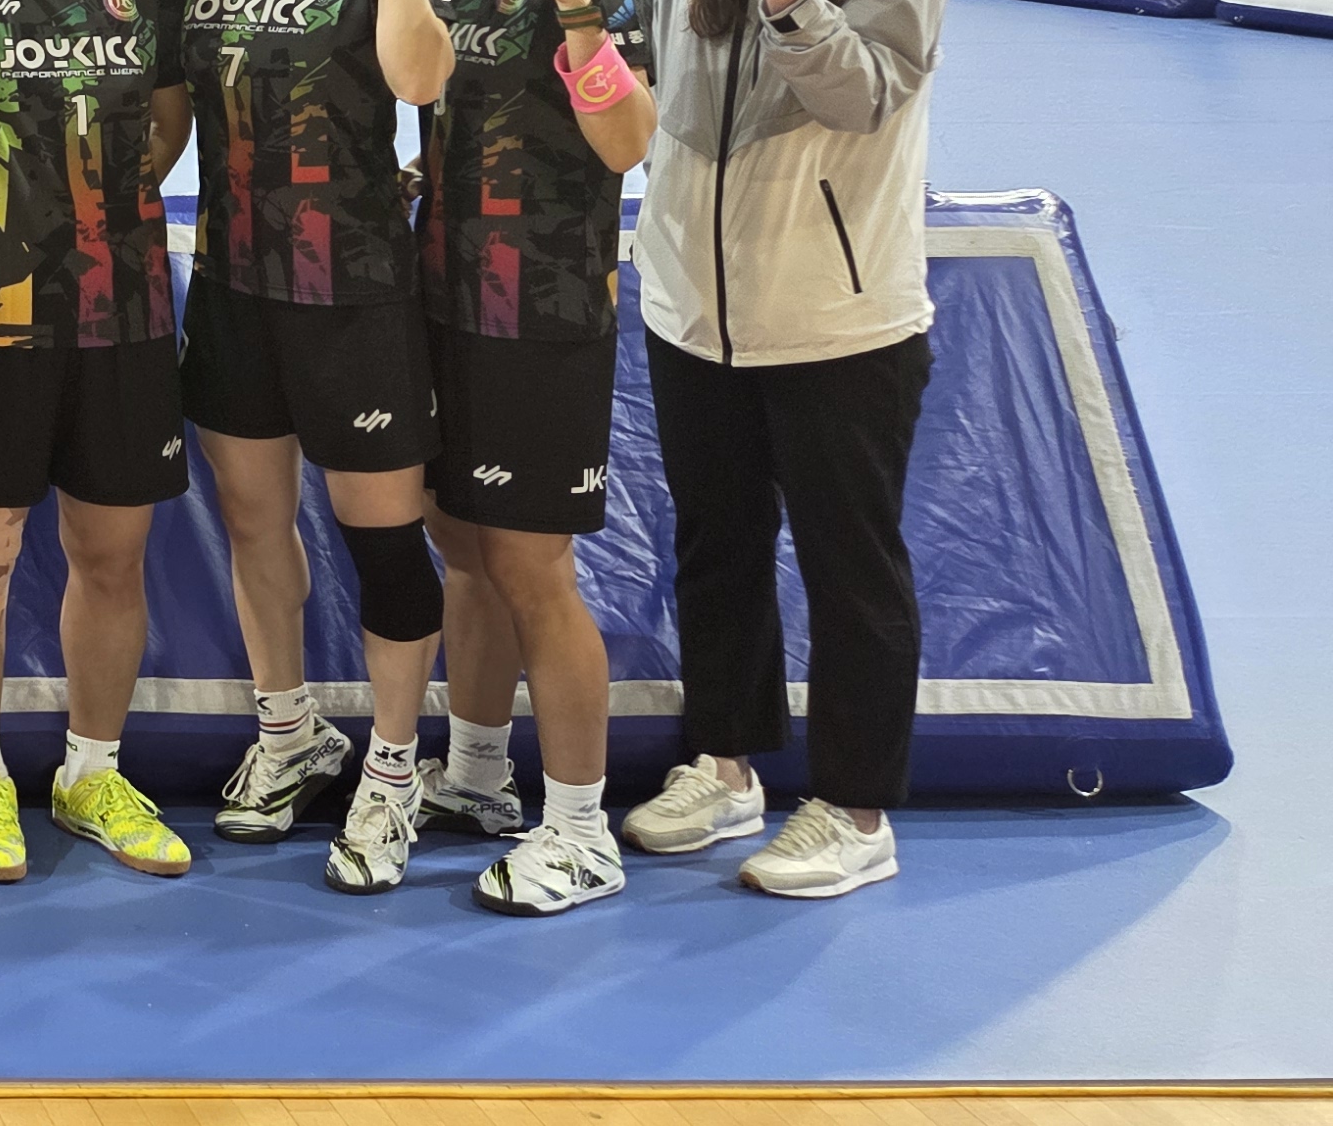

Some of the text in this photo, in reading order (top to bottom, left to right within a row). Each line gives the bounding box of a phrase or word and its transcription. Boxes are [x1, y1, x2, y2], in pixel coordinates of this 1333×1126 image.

[448, 23, 508, 57] KICK
[2, 69, 106, 78] PERFORMANCE
[220, 46, 246, 87] 7
[71, 94, 88, 136] 1
